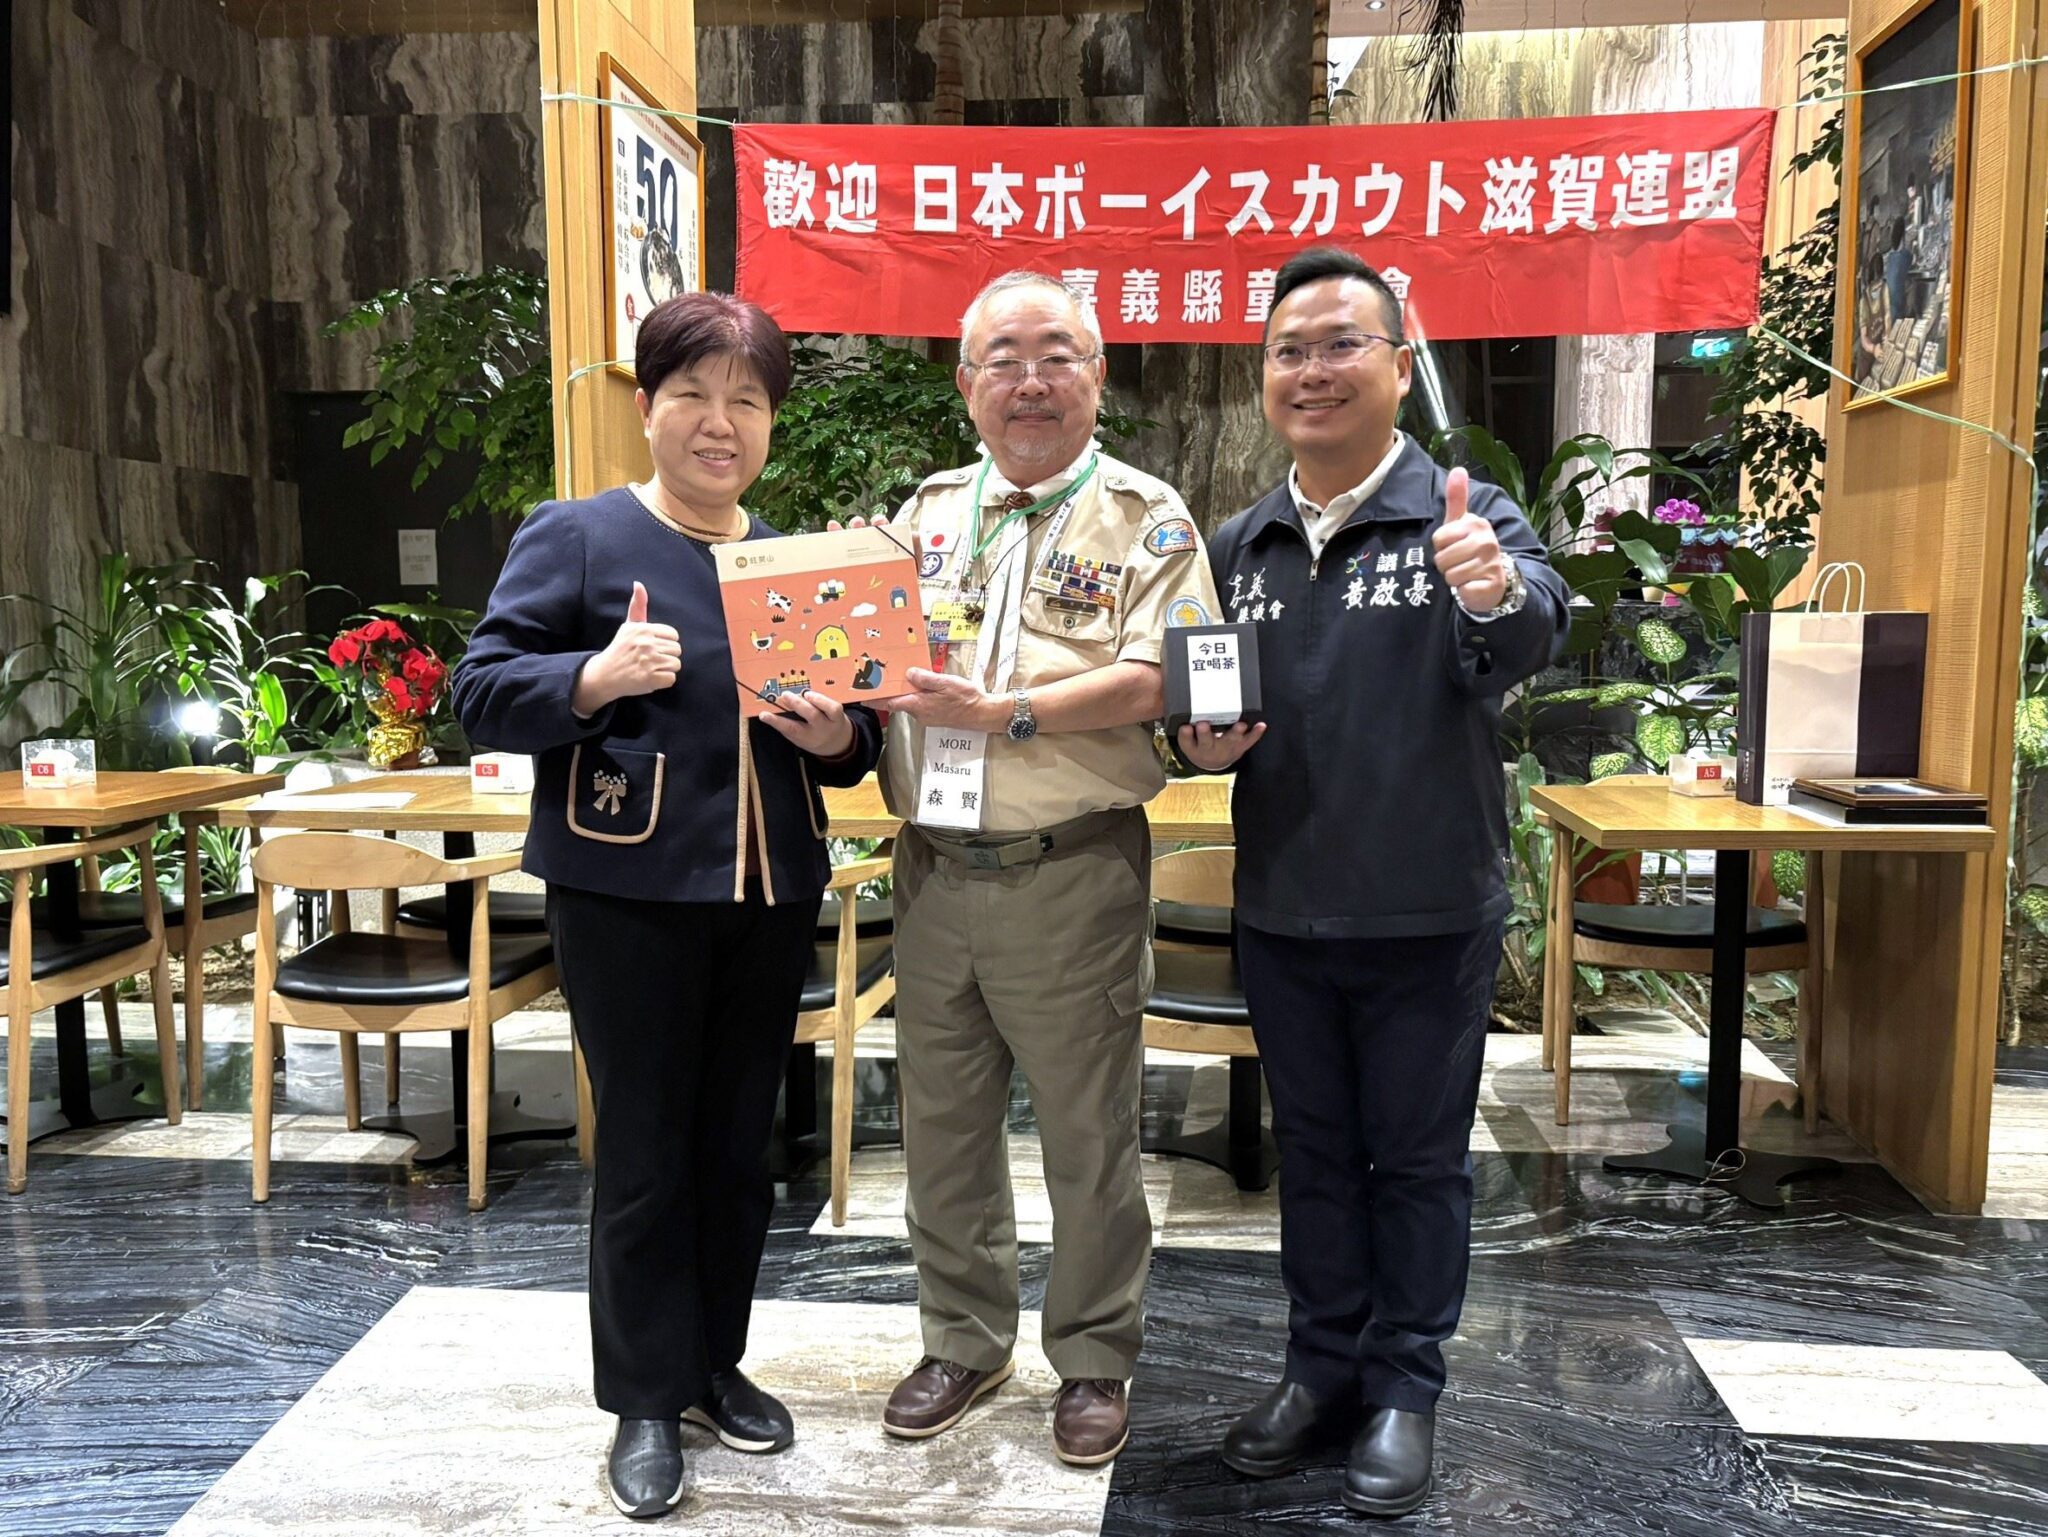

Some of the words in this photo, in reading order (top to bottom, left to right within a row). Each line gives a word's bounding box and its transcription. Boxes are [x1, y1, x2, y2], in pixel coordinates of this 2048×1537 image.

[637, 134, 678, 253] 50
[763, 158, 879, 233] 歡迎
[913, 146, 1741, 241] 日本ボーイスカウト滋賀連盟
[1376, 546, 1425, 573] 議員
[1199, 642, 1227, 656] 今日
[1192, 656, 1237, 672] 宜喝茶
[939, 738, 972, 751] MORI
[37, 765, 49, 775] C6
[481, 765, 494, 776] C5
[933, 762, 971, 776] Masaru
[1703, 767, 1716, 778] A5
[926, 787, 943, 807] 森
[961, 791, 978, 810] 賢
